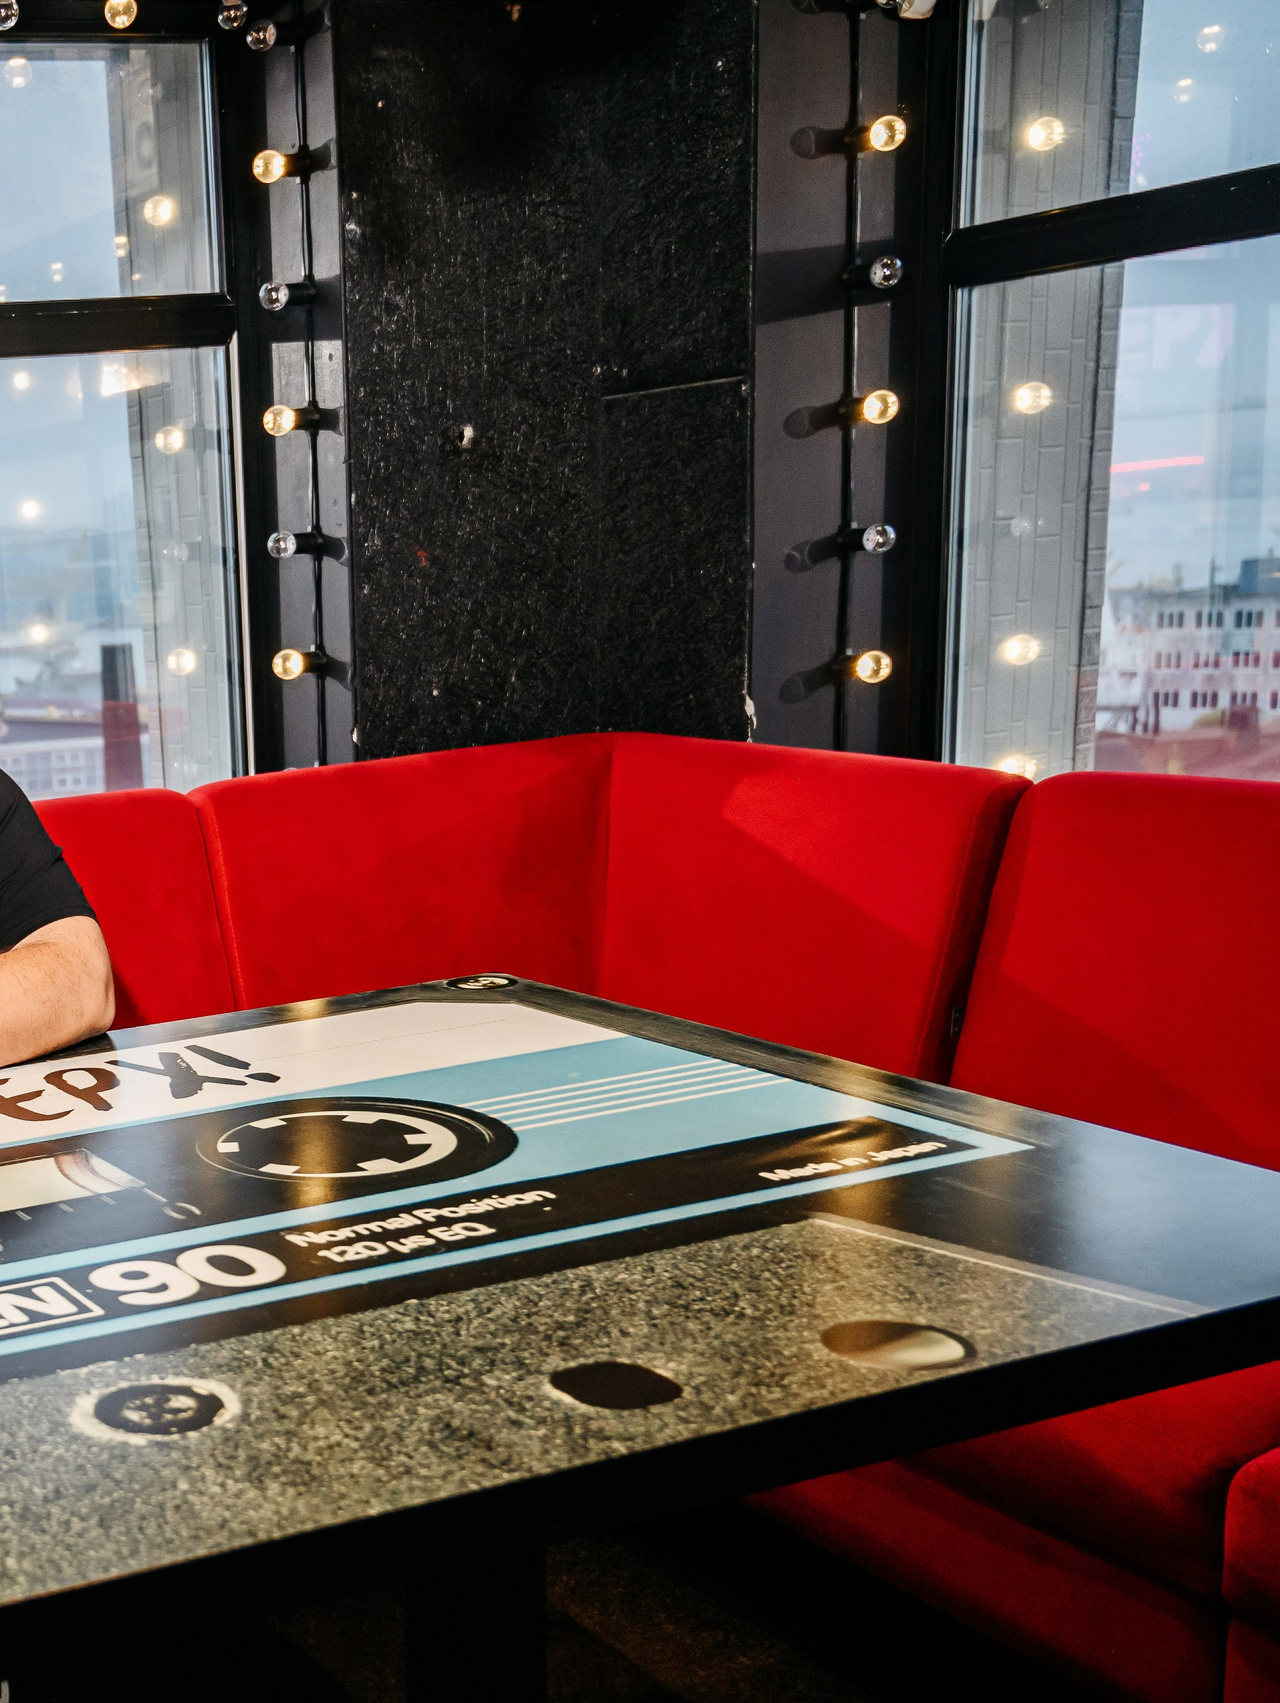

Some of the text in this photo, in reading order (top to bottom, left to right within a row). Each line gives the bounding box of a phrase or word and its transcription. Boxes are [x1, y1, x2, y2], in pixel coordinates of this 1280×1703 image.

[758, 1163, 843, 1182] Made
[867, 1141, 948, 1162] Japan
[285, 1190, 557, 1248] Normal Position
[317, 1241, 389, 1263] 120
[427, 1222, 497, 1241] EQ
[89, 1244, 287, 1306] 90
